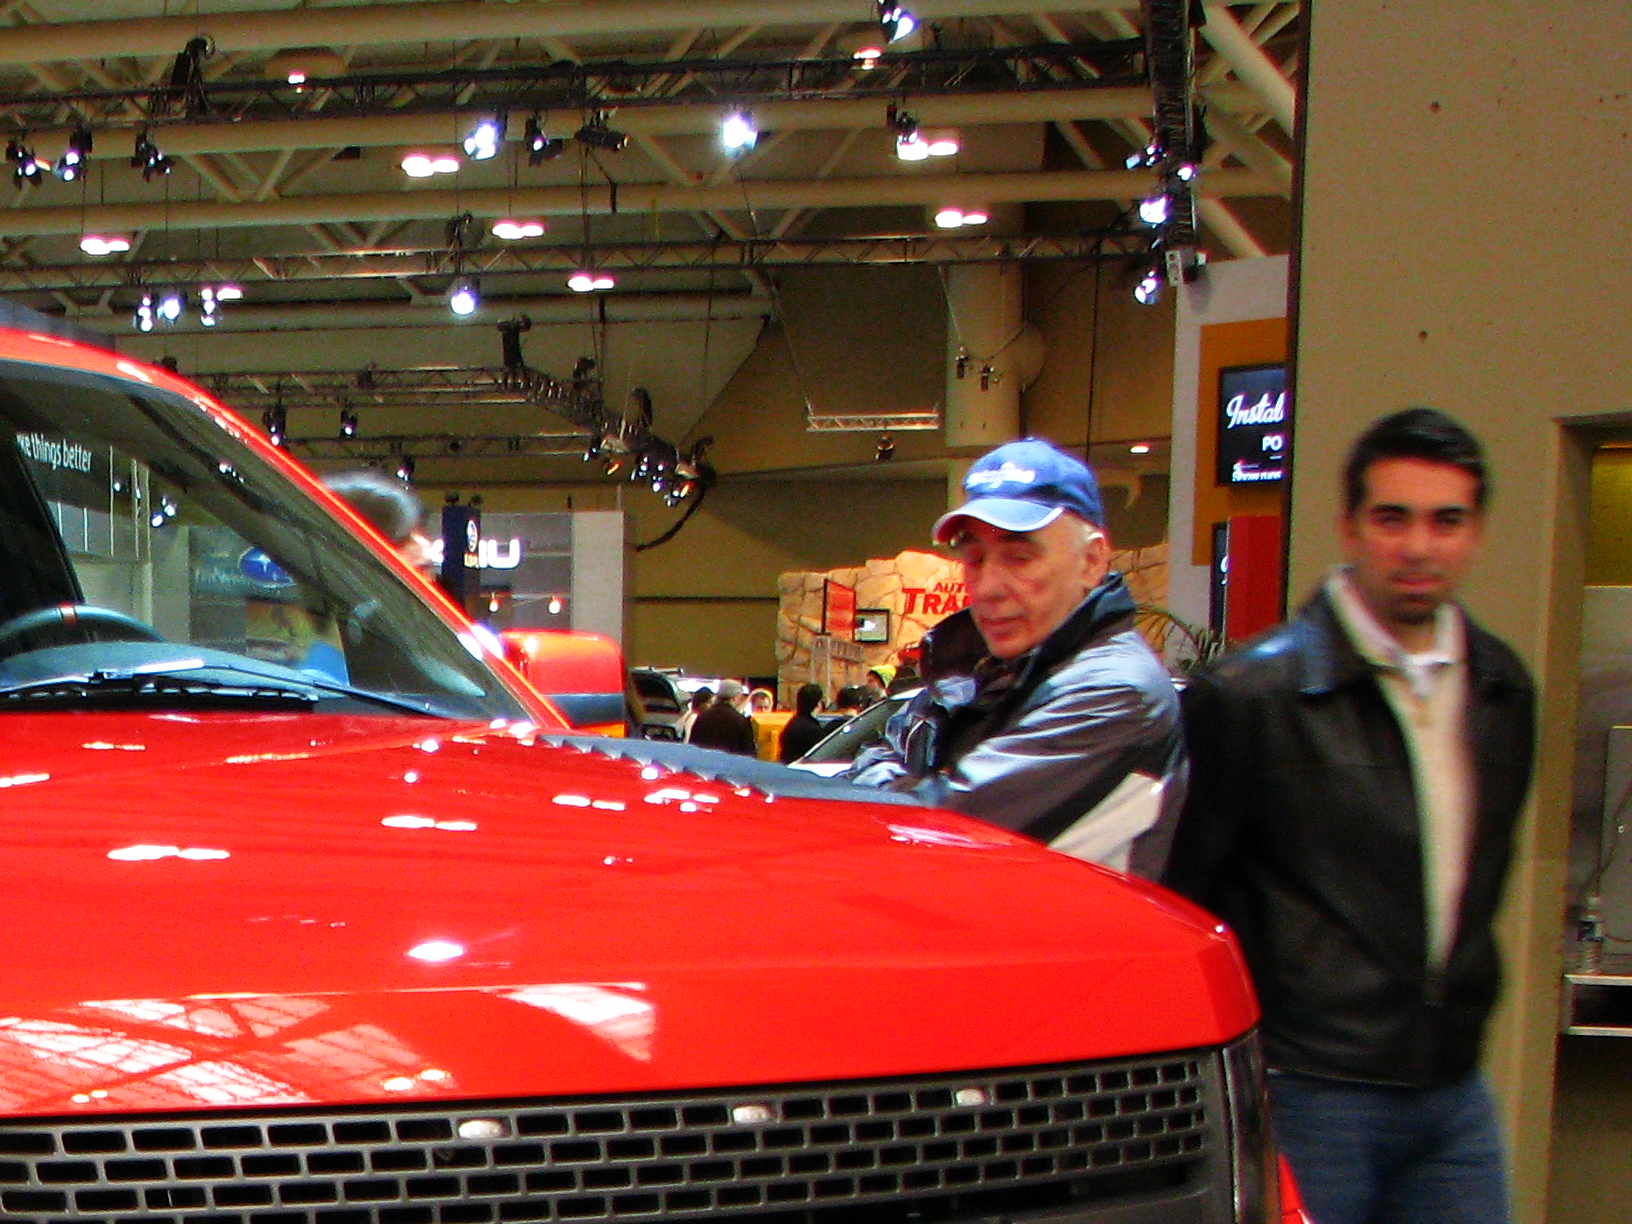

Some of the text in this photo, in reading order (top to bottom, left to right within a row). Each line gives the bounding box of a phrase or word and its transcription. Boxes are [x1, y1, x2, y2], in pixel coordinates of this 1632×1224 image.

[1226, 391, 1285, 429] Instal
[30, 433, 62, 470] things
[62, 439, 92, 473] better
[933, 582, 970, 593] AUT
